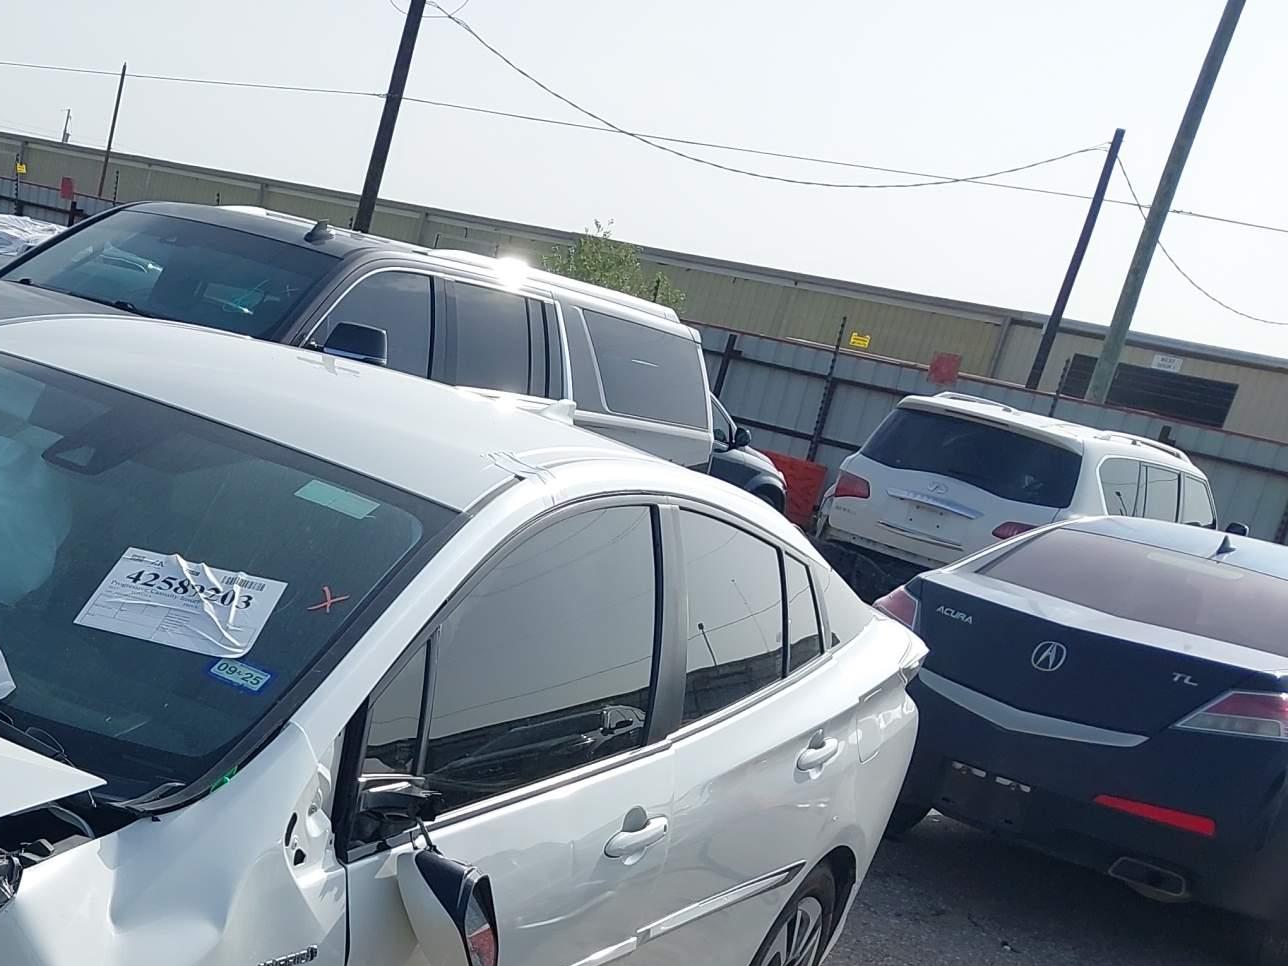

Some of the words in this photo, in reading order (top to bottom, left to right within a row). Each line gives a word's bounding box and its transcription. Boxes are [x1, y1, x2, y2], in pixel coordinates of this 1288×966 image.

[126, 570, 253, 609] 42589203
[936, 605, 973, 625] ACURA
[1172, 672, 1199, 687] TL
